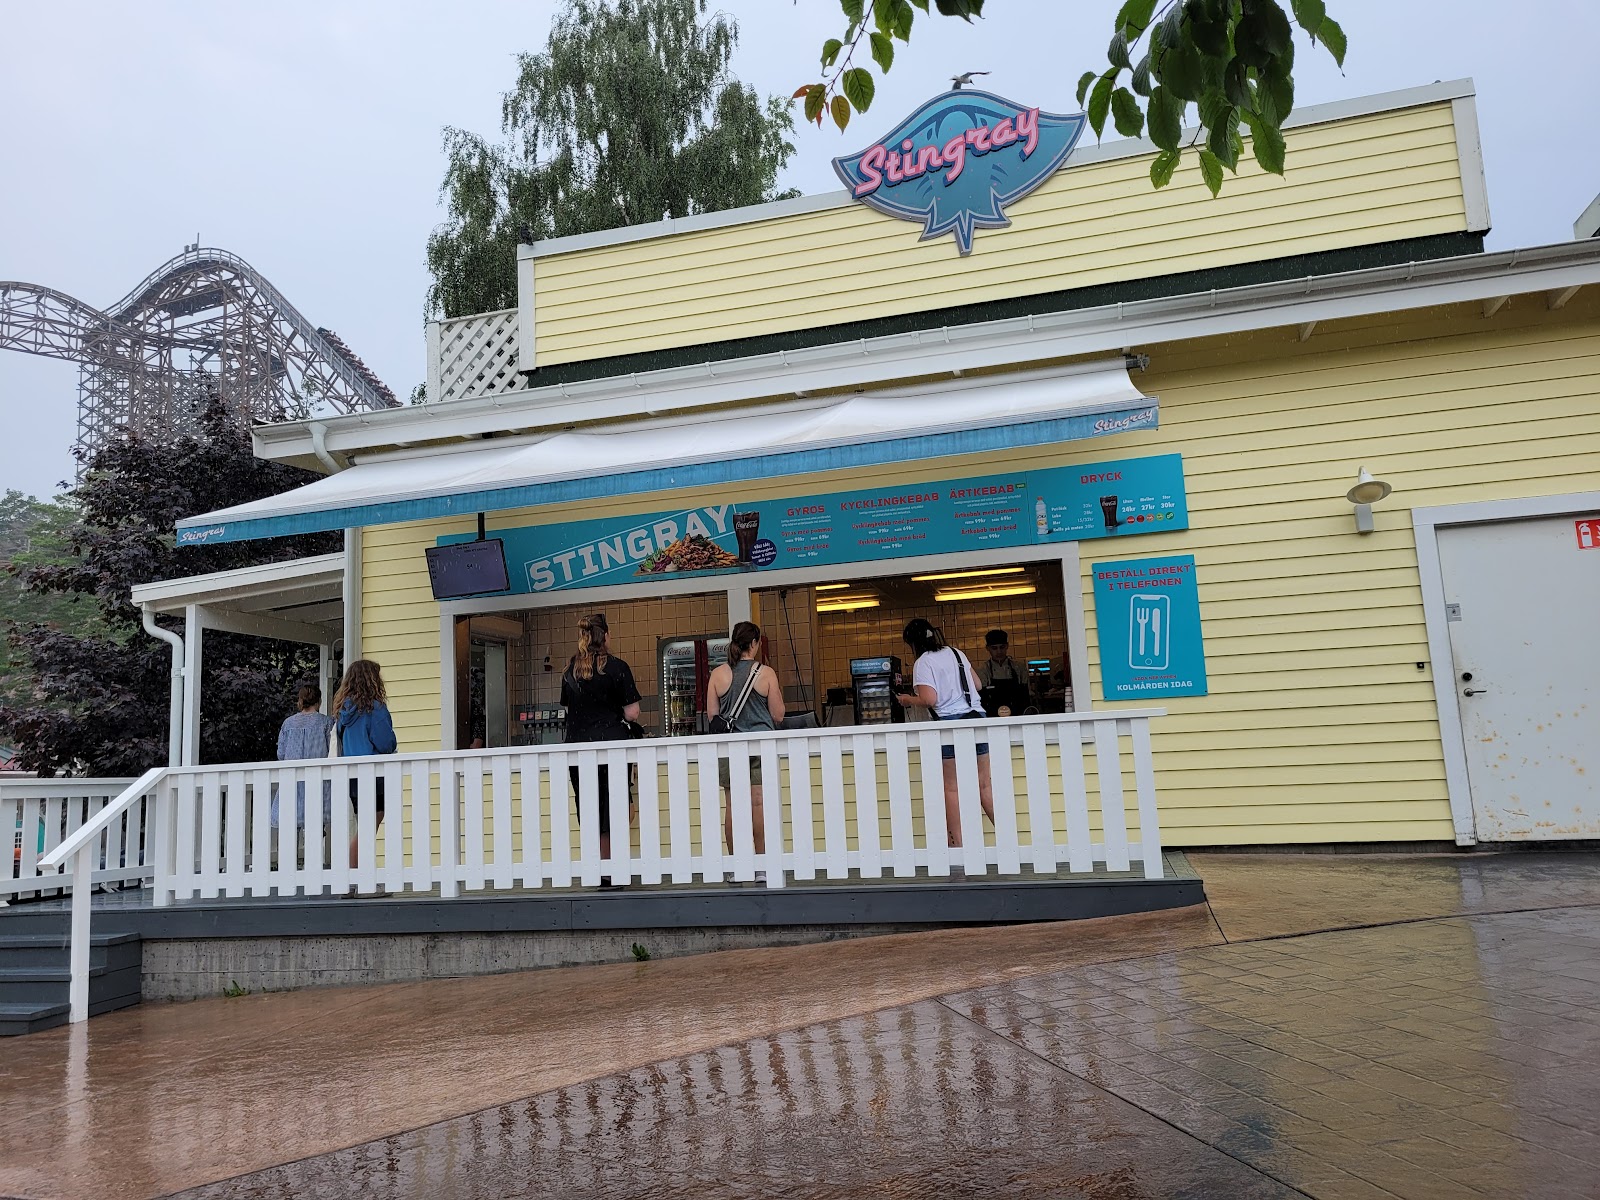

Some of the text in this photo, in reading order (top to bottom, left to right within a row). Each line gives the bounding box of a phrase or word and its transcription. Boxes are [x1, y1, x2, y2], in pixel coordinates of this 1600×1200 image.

[854, 107, 1039, 198] Stingray
[1093, 410, 1153, 434] Stingray
[1080, 471, 1122, 484] DRYCK
[950, 484, 1014, 499] ÄRTKEBAB
[841, 493, 939, 510] KYCKLINGKEBAB
[787, 505, 825, 516] GYROS
[180, 526, 225, 542] Stingray
[529, 504, 728, 591] STINGRAY
[1098, 564, 1191, 580] BESTÄLL DIREKT
[1109, 577, 1182, 591] I TELEFONEN
[1117, 680, 1193, 691] KOLMÅRDEN IDAG
